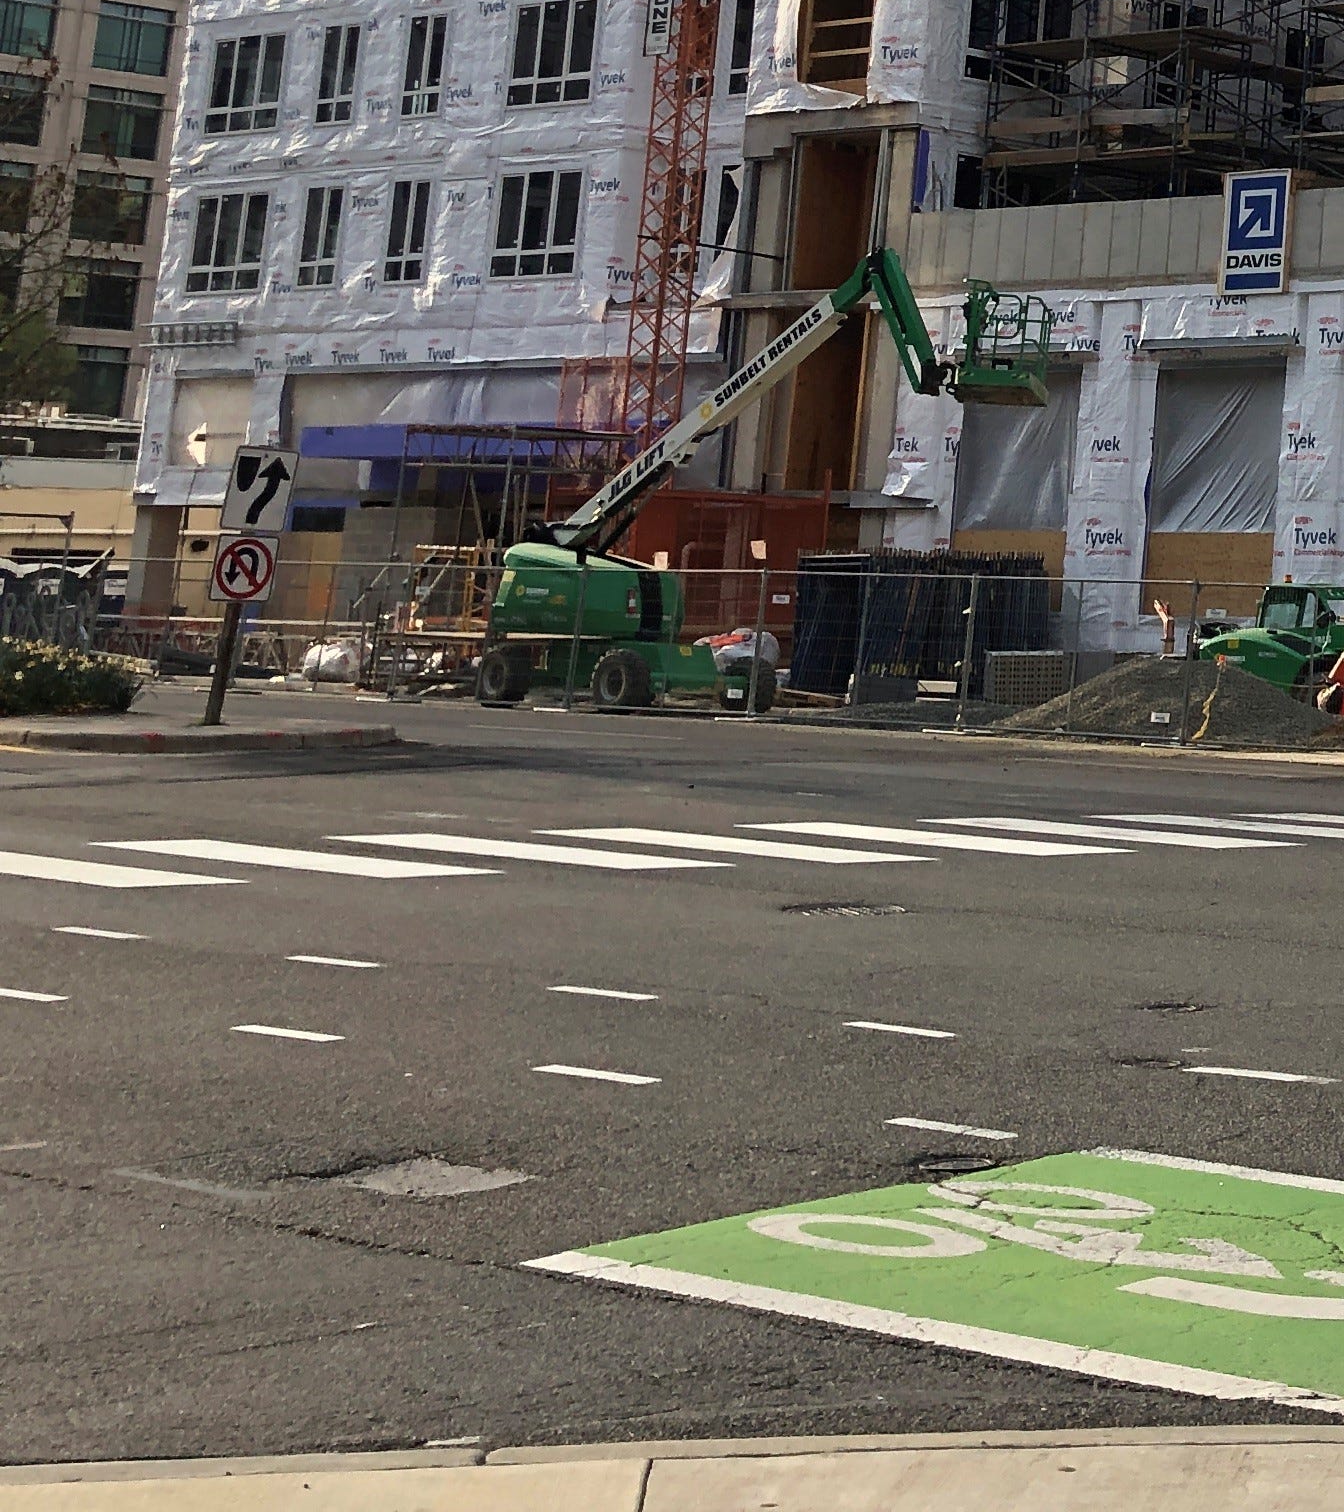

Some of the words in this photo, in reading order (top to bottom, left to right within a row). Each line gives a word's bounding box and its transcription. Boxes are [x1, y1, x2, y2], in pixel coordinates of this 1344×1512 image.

[882, 46, 918, 64] Tyvek
[1226, 253, 1282, 269] DAVIS
[714, 357, 767, 407] SUNBELT
[768, 308, 823, 361] RENTALS
[608, 477, 632, 503] JLG
[636, 441, 667, 479] LIFT
[1295, 528, 1336, 549] Tyvek
